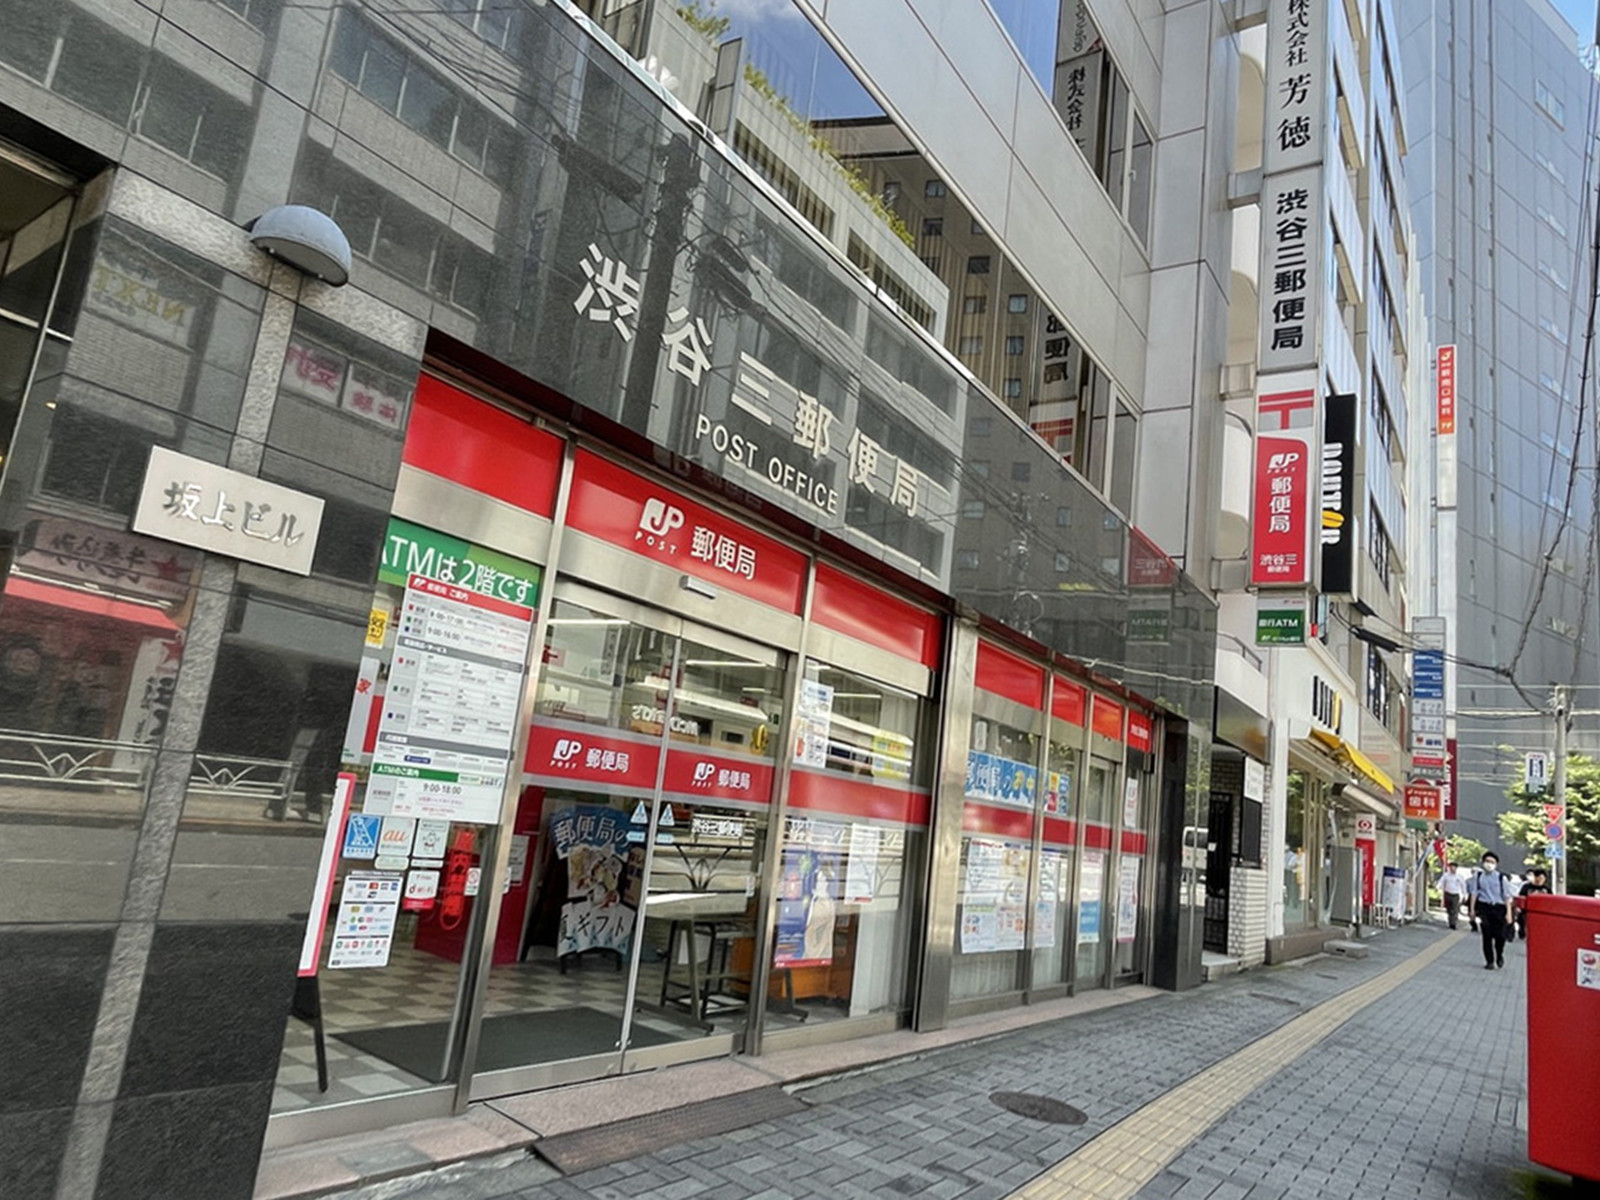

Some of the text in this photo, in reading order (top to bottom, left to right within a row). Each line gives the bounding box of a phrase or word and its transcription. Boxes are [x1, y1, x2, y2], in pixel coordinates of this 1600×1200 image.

[1276, 0, 1312, 152] 株式会社 芳徳
[1271, 188, 1310, 351] 渋谷三郵便局
[574, 242, 919, 519] 渋谷三郵便局
[695, 413, 759, 470] POST
[768, 456, 839, 515] OFFICE
[163, 480, 305, 547] 坂上ビル
[1269, 476, 1293, 534] 郵便局
[634, 530, 677, 555] POST
[690, 525, 757, 580] 郵便局
[1259, 553, 1298, 566] 渋谷三
[550, 760, 577, 770] POST
[585, 747, 630, 774] 郵便局
[718, 769, 751, 790] 郵便局
[383, 829, 407, 843] au
[554, 815, 630, 848] 郵便局の
